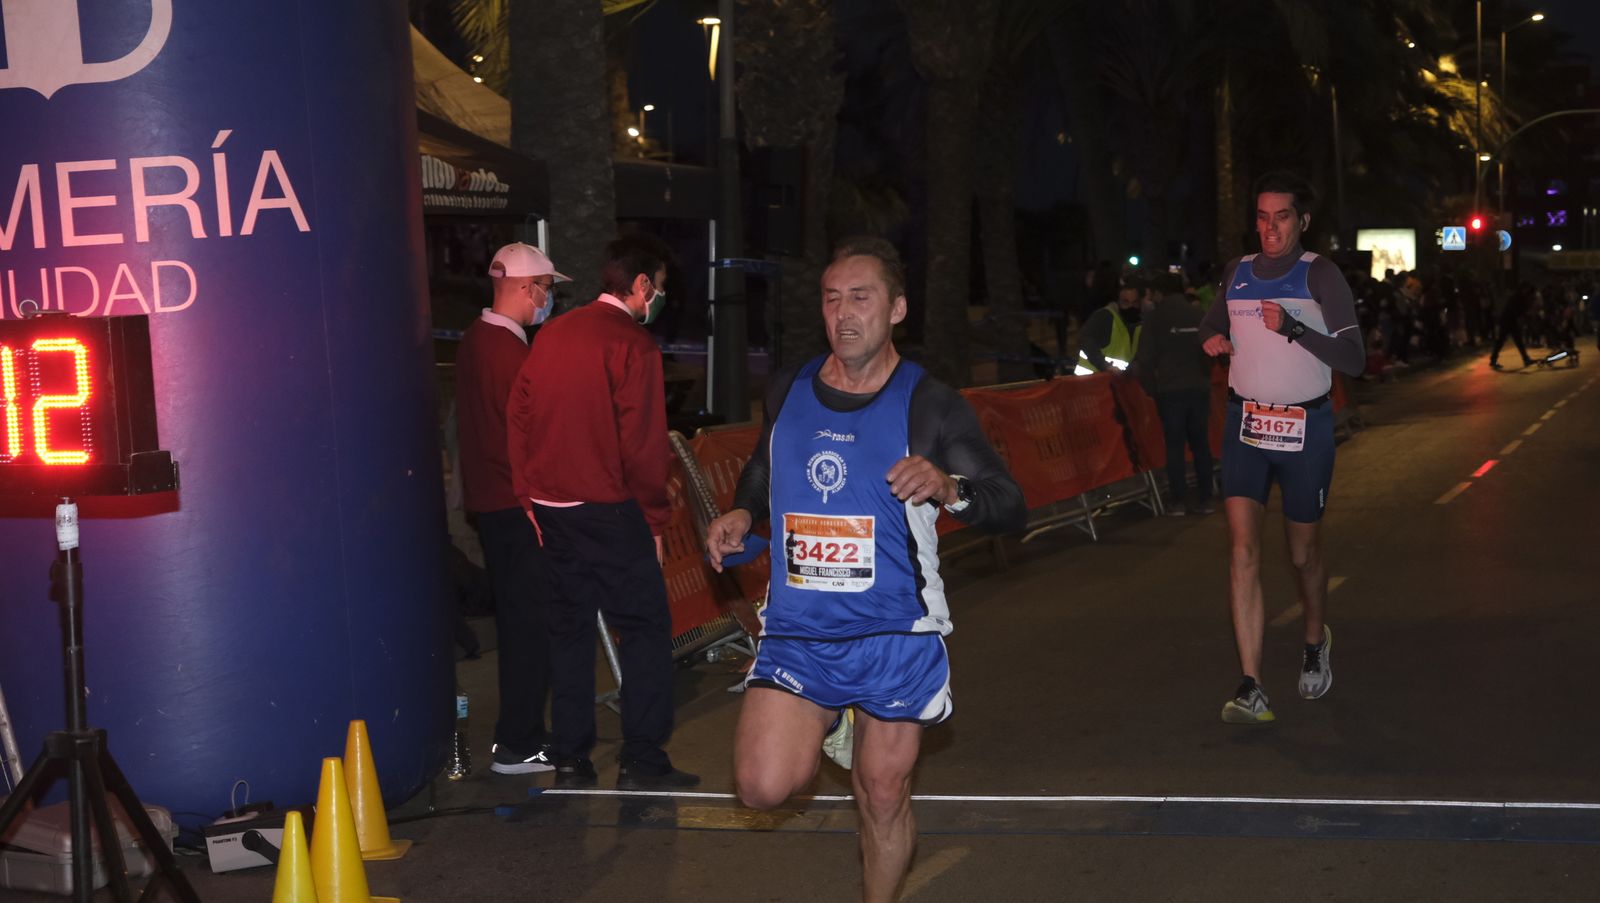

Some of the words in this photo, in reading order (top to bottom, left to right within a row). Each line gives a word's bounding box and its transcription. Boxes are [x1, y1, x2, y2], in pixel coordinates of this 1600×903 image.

[1253, 418, 1295, 434] 3167
[795, 540, 859, 563] 3422
[799, 566, 818, 576] MIGUEL
[818, 567, 851, 578] FRANCISCO
